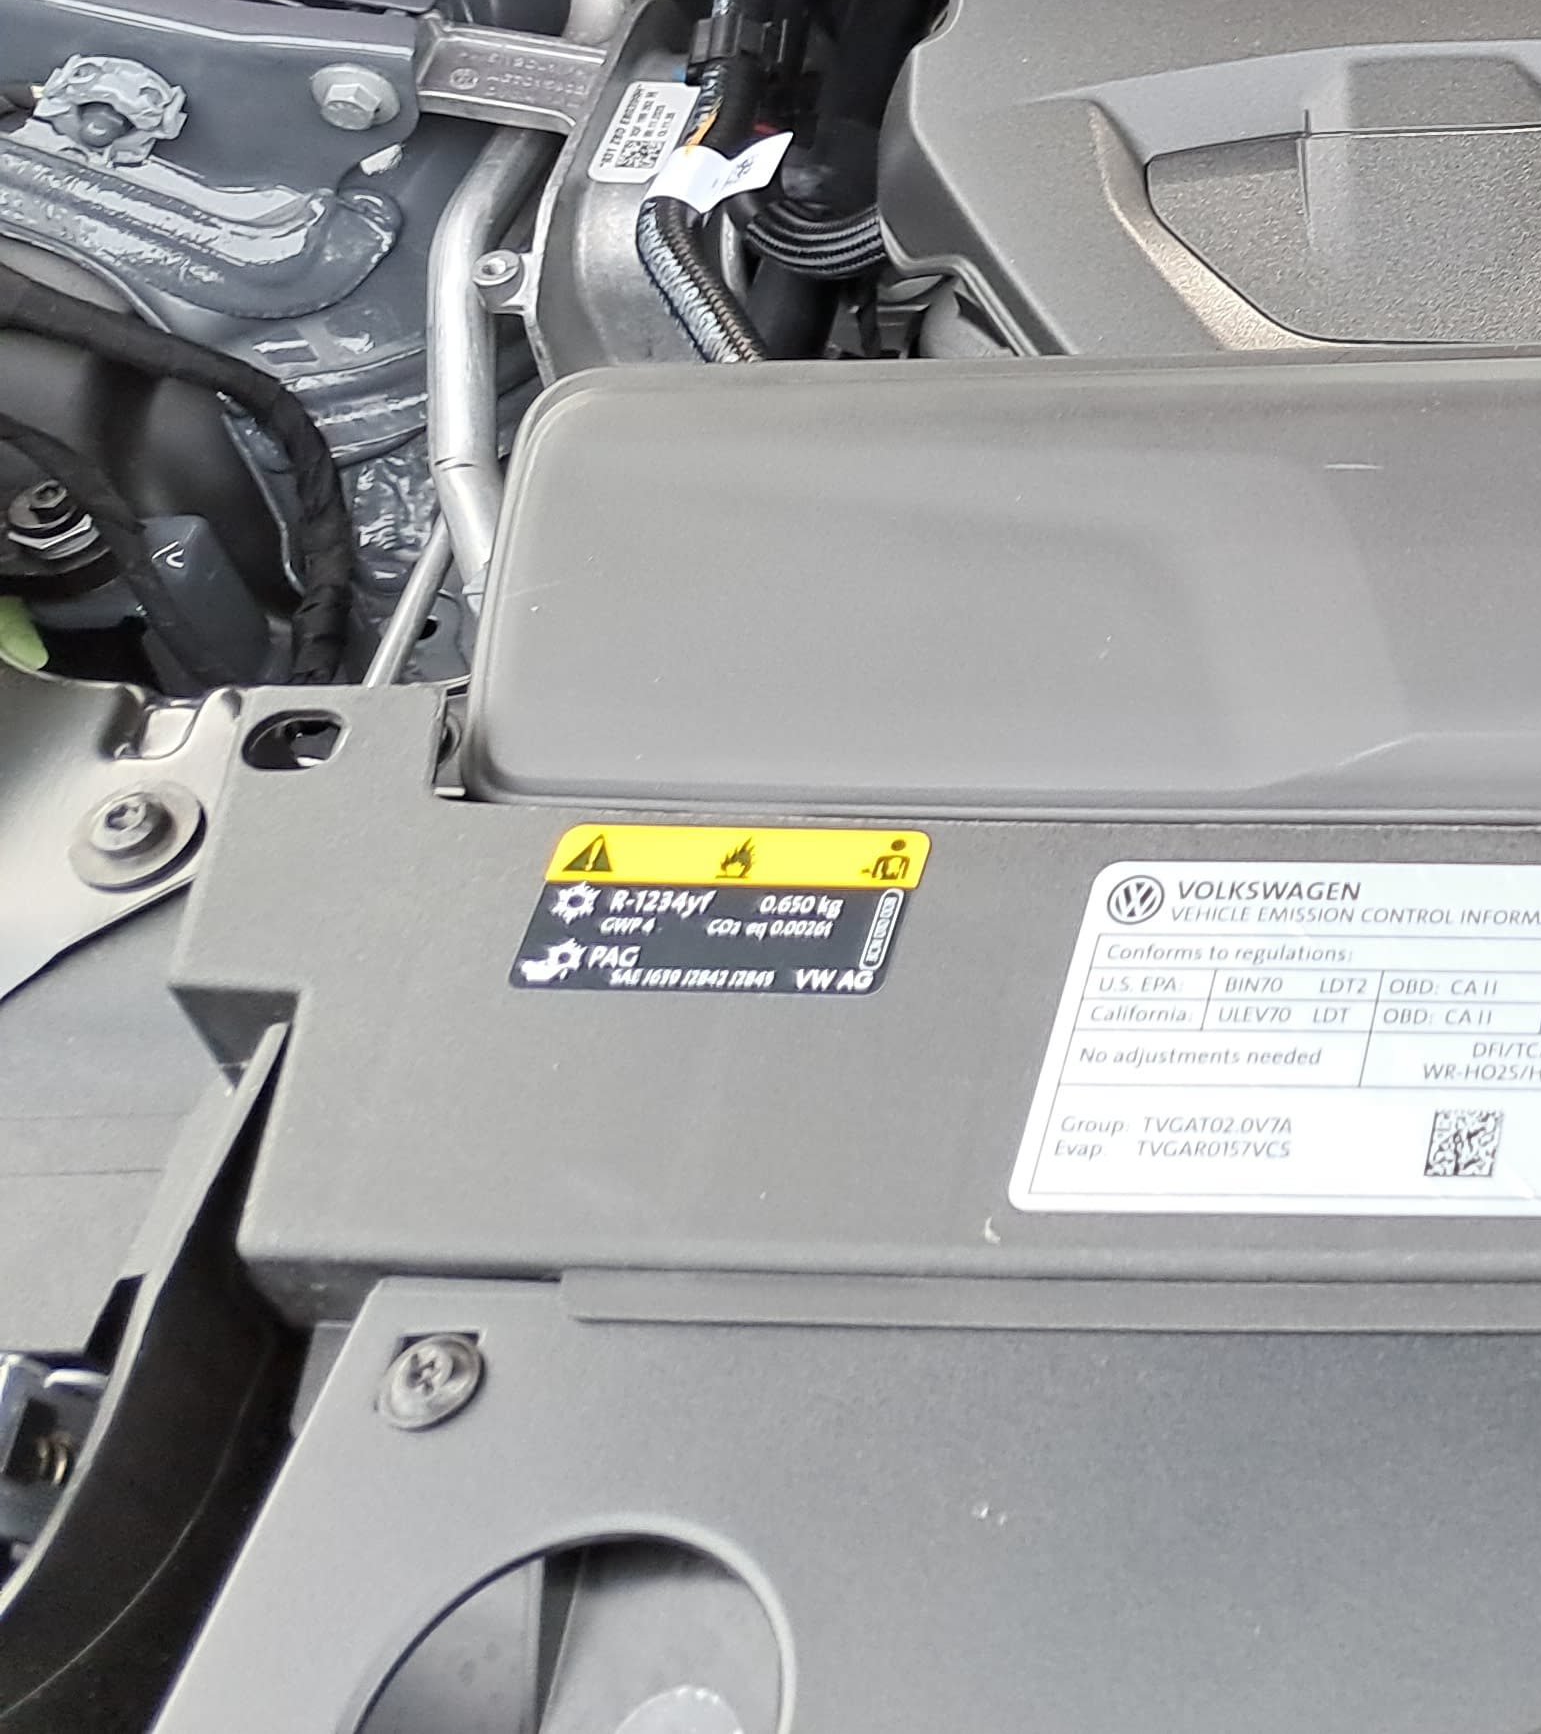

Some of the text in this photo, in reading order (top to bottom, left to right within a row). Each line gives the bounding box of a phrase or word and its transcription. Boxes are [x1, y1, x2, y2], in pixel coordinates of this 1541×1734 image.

[1178, 881, 1361, 901] VOLKSWAGEN
[609, 890, 717, 920] R-1234yf
[760, 895, 844, 919] 0.650 kg
[1171, 906, 1250, 923] VEHICLE
[1257, 906, 1354, 923] EMISSION
[1361, 908, 1453, 925] CONTROL
[600, 917, 656, 935] GWP 4
[745, 922, 768, 940] eq
[588, 946, 642, 968] PAG
[1107, 943, 1353, 964] Conforms to regulations:
[796, 970, 874, 991] VW AG
[1099, 977, 1133, 992] U.S.
[1225, 977, 1283, 993] BIN70
[1319, 978, 1368, 993] LDT2
[1389, 978, 1439, 995] OBD:
[1450, 978, 1478, 995] CA
[1090, 1005, 1192, 1022] California:
[1218, 1006, 1292, 1023] ULEV70
[1313, 1006, 1351, 1023] LDT
[1383, 1007, 1433, 1025] OBD:
[1445, 1007, 1472, 1025] CA
[1079, 1047, 1322, 1067] No adjustments needed
